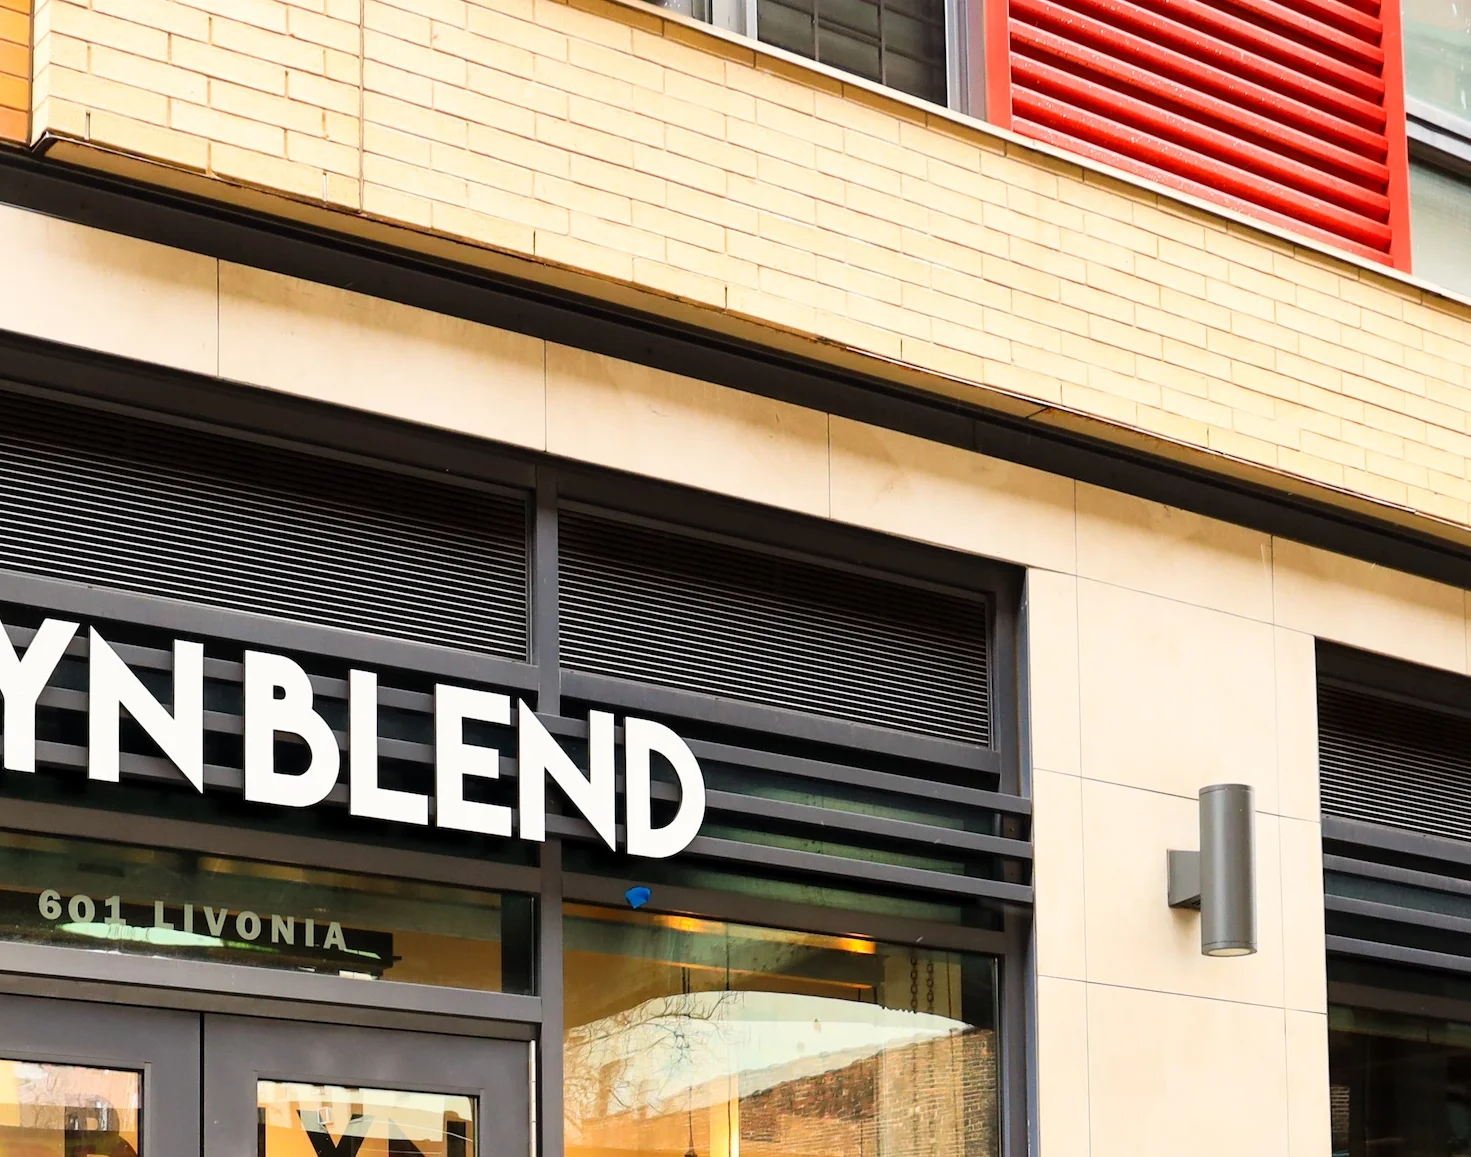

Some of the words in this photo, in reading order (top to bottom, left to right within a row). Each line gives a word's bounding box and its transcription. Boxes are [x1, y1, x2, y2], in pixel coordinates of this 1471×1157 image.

[243, 649, 707, 858] BLEND
[38, 889, 127, 925] 601
[154, 900, 348, 950] LIVONIA
